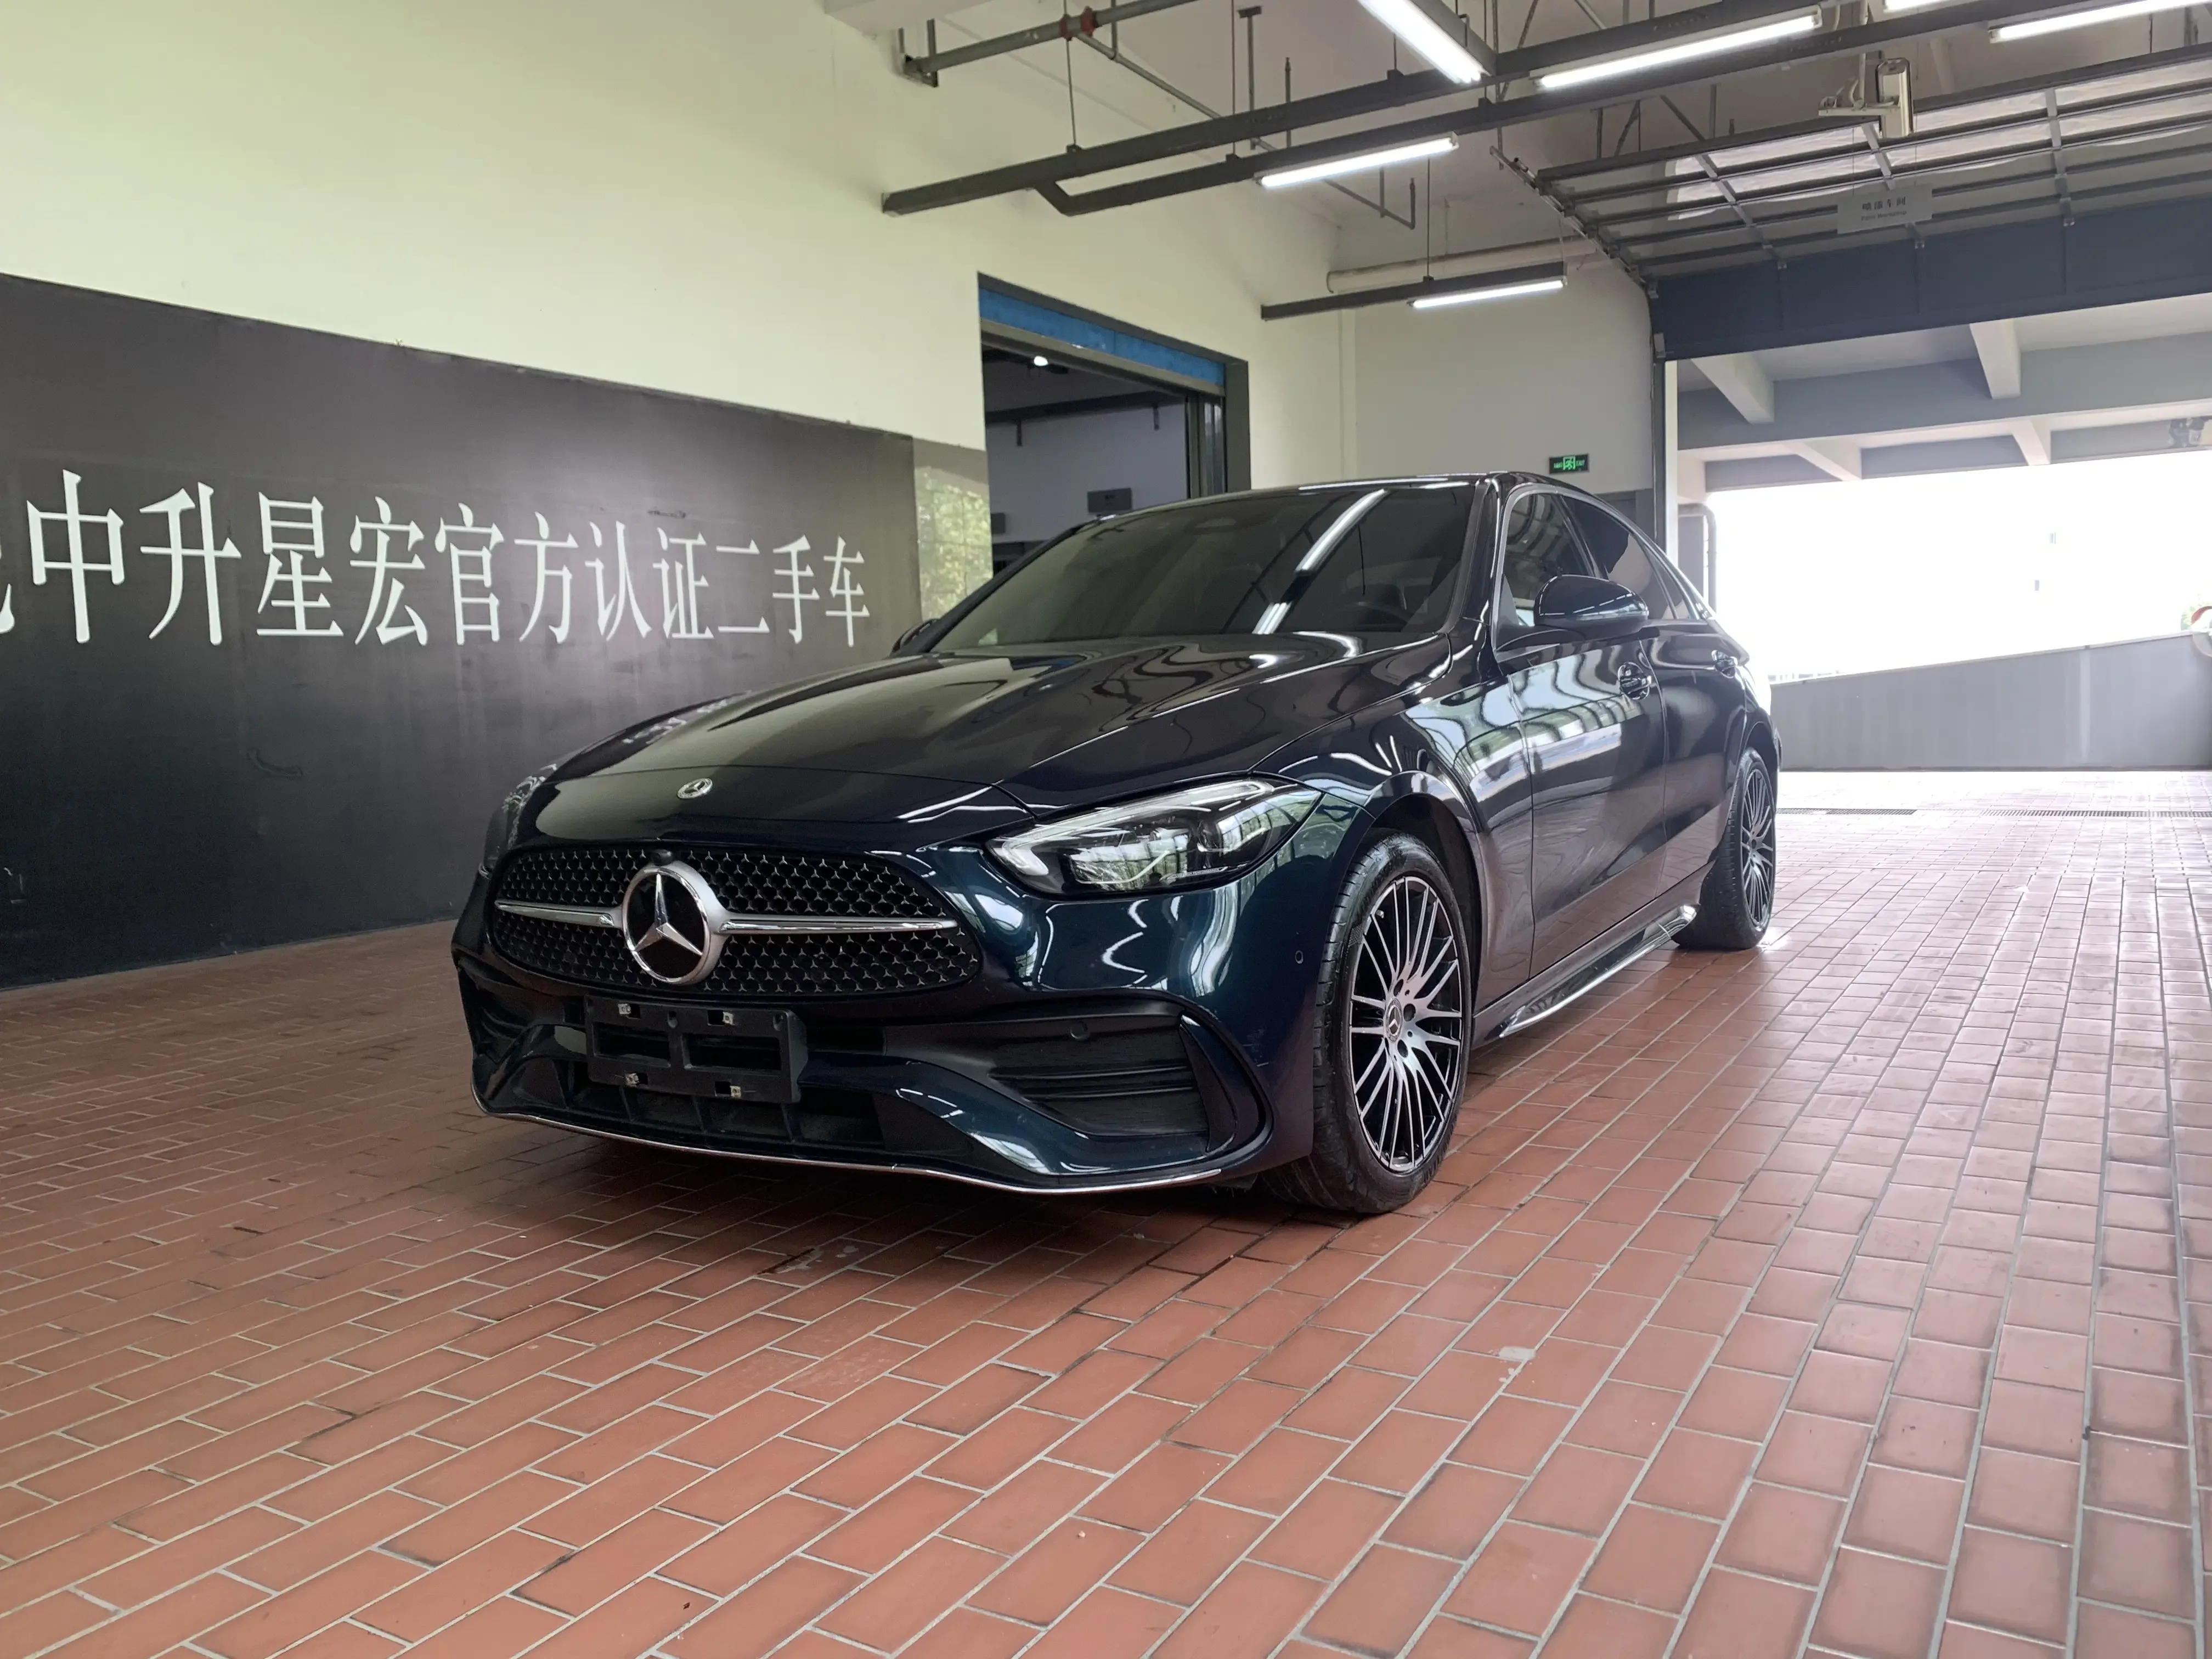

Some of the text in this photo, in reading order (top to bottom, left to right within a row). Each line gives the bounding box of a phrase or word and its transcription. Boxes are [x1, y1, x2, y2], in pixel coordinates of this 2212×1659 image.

[0, 470, 870, 647] 中升星宏官方认证二手车
